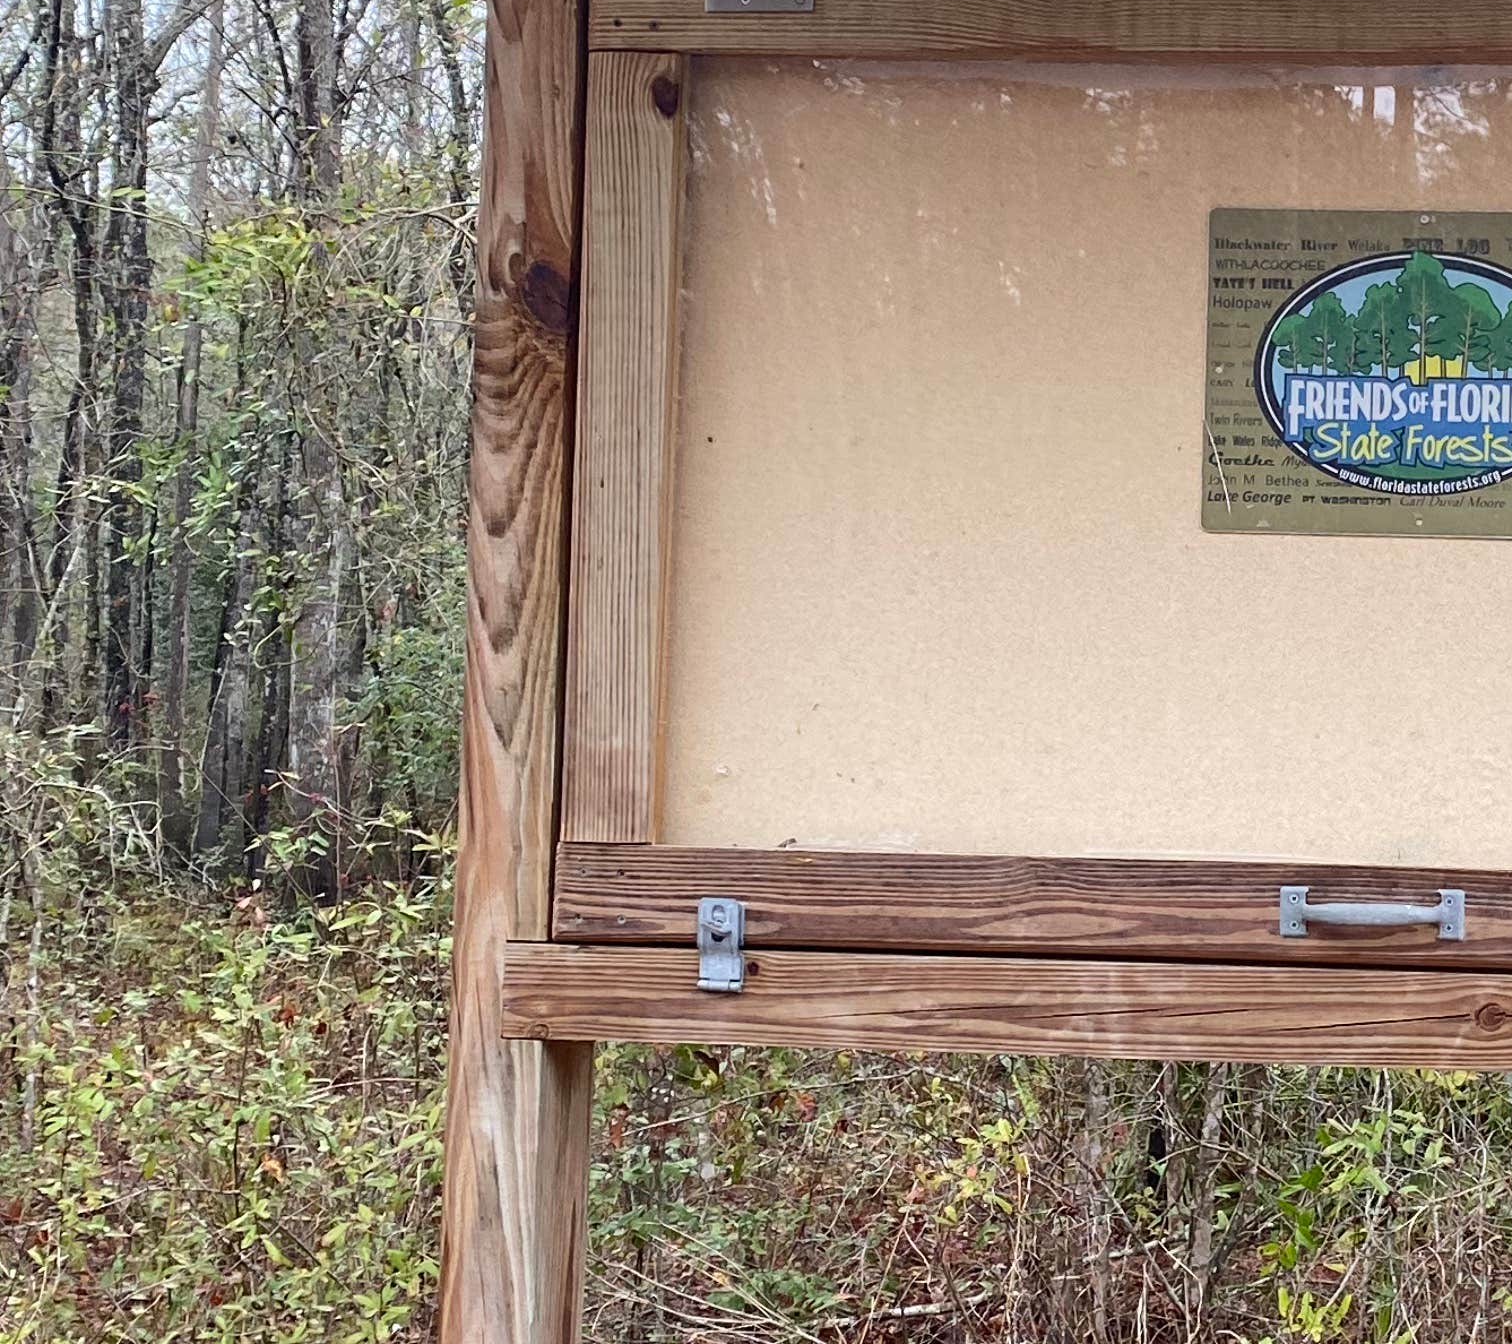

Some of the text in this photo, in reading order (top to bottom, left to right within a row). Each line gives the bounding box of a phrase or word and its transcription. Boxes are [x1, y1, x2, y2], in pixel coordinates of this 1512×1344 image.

[1301, 239, 1338, 251] River
[1215, 258, 1326, 271] WITHLACOOCHEE
[1262, 278, 1295, 289] HELL
[1213, 296, 1273, 312] Holopaw
[1288, 379, 1407, 436] FRIENDS
[1210, 412, 1263, 426] Twin Rivers
[1313, 422, 1394, 461] State
[1208, 451, 1275, 467] Goethe
[1243, 475, 1256, 485] M
[1265, 475, 1309, 487] Bethea
[1339, 468, 1501, 494] www.floridastateforests.org
[1207, 490, 1292, 506] Lake George
[1399, 496, 1506, 508] Carl Duval Moore
